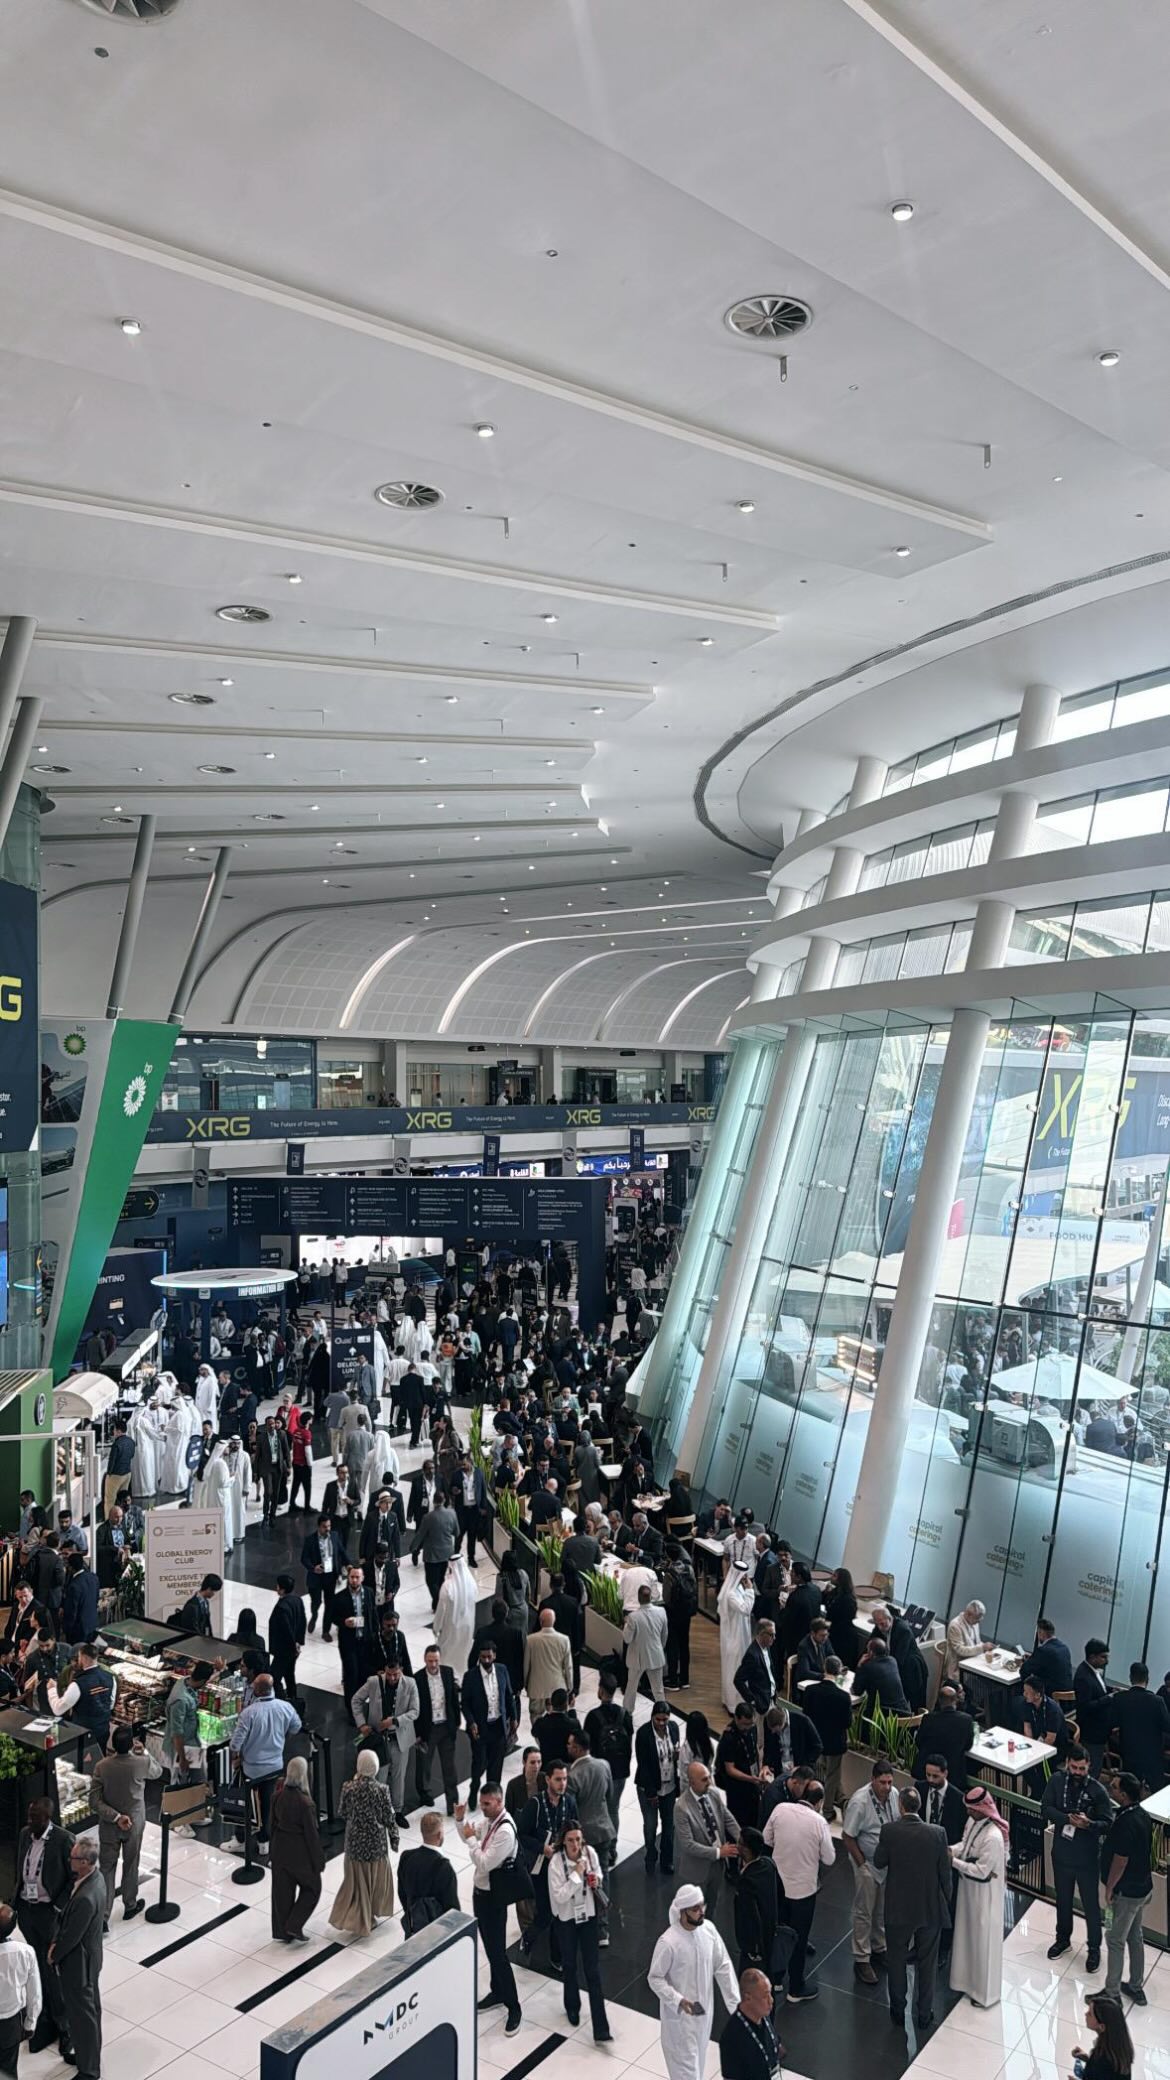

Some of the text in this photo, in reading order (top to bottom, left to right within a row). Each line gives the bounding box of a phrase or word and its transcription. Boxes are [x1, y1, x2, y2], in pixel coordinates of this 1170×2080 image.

[143, 1062, 154, 1075] bp
[406, 1112, 451, 1129] XRG
[566, 1109, 601, 1125] XRG
[186, 1116, 250, 1138] XRG
[159, 1574, 199, 1582] EXCLUSIVE
